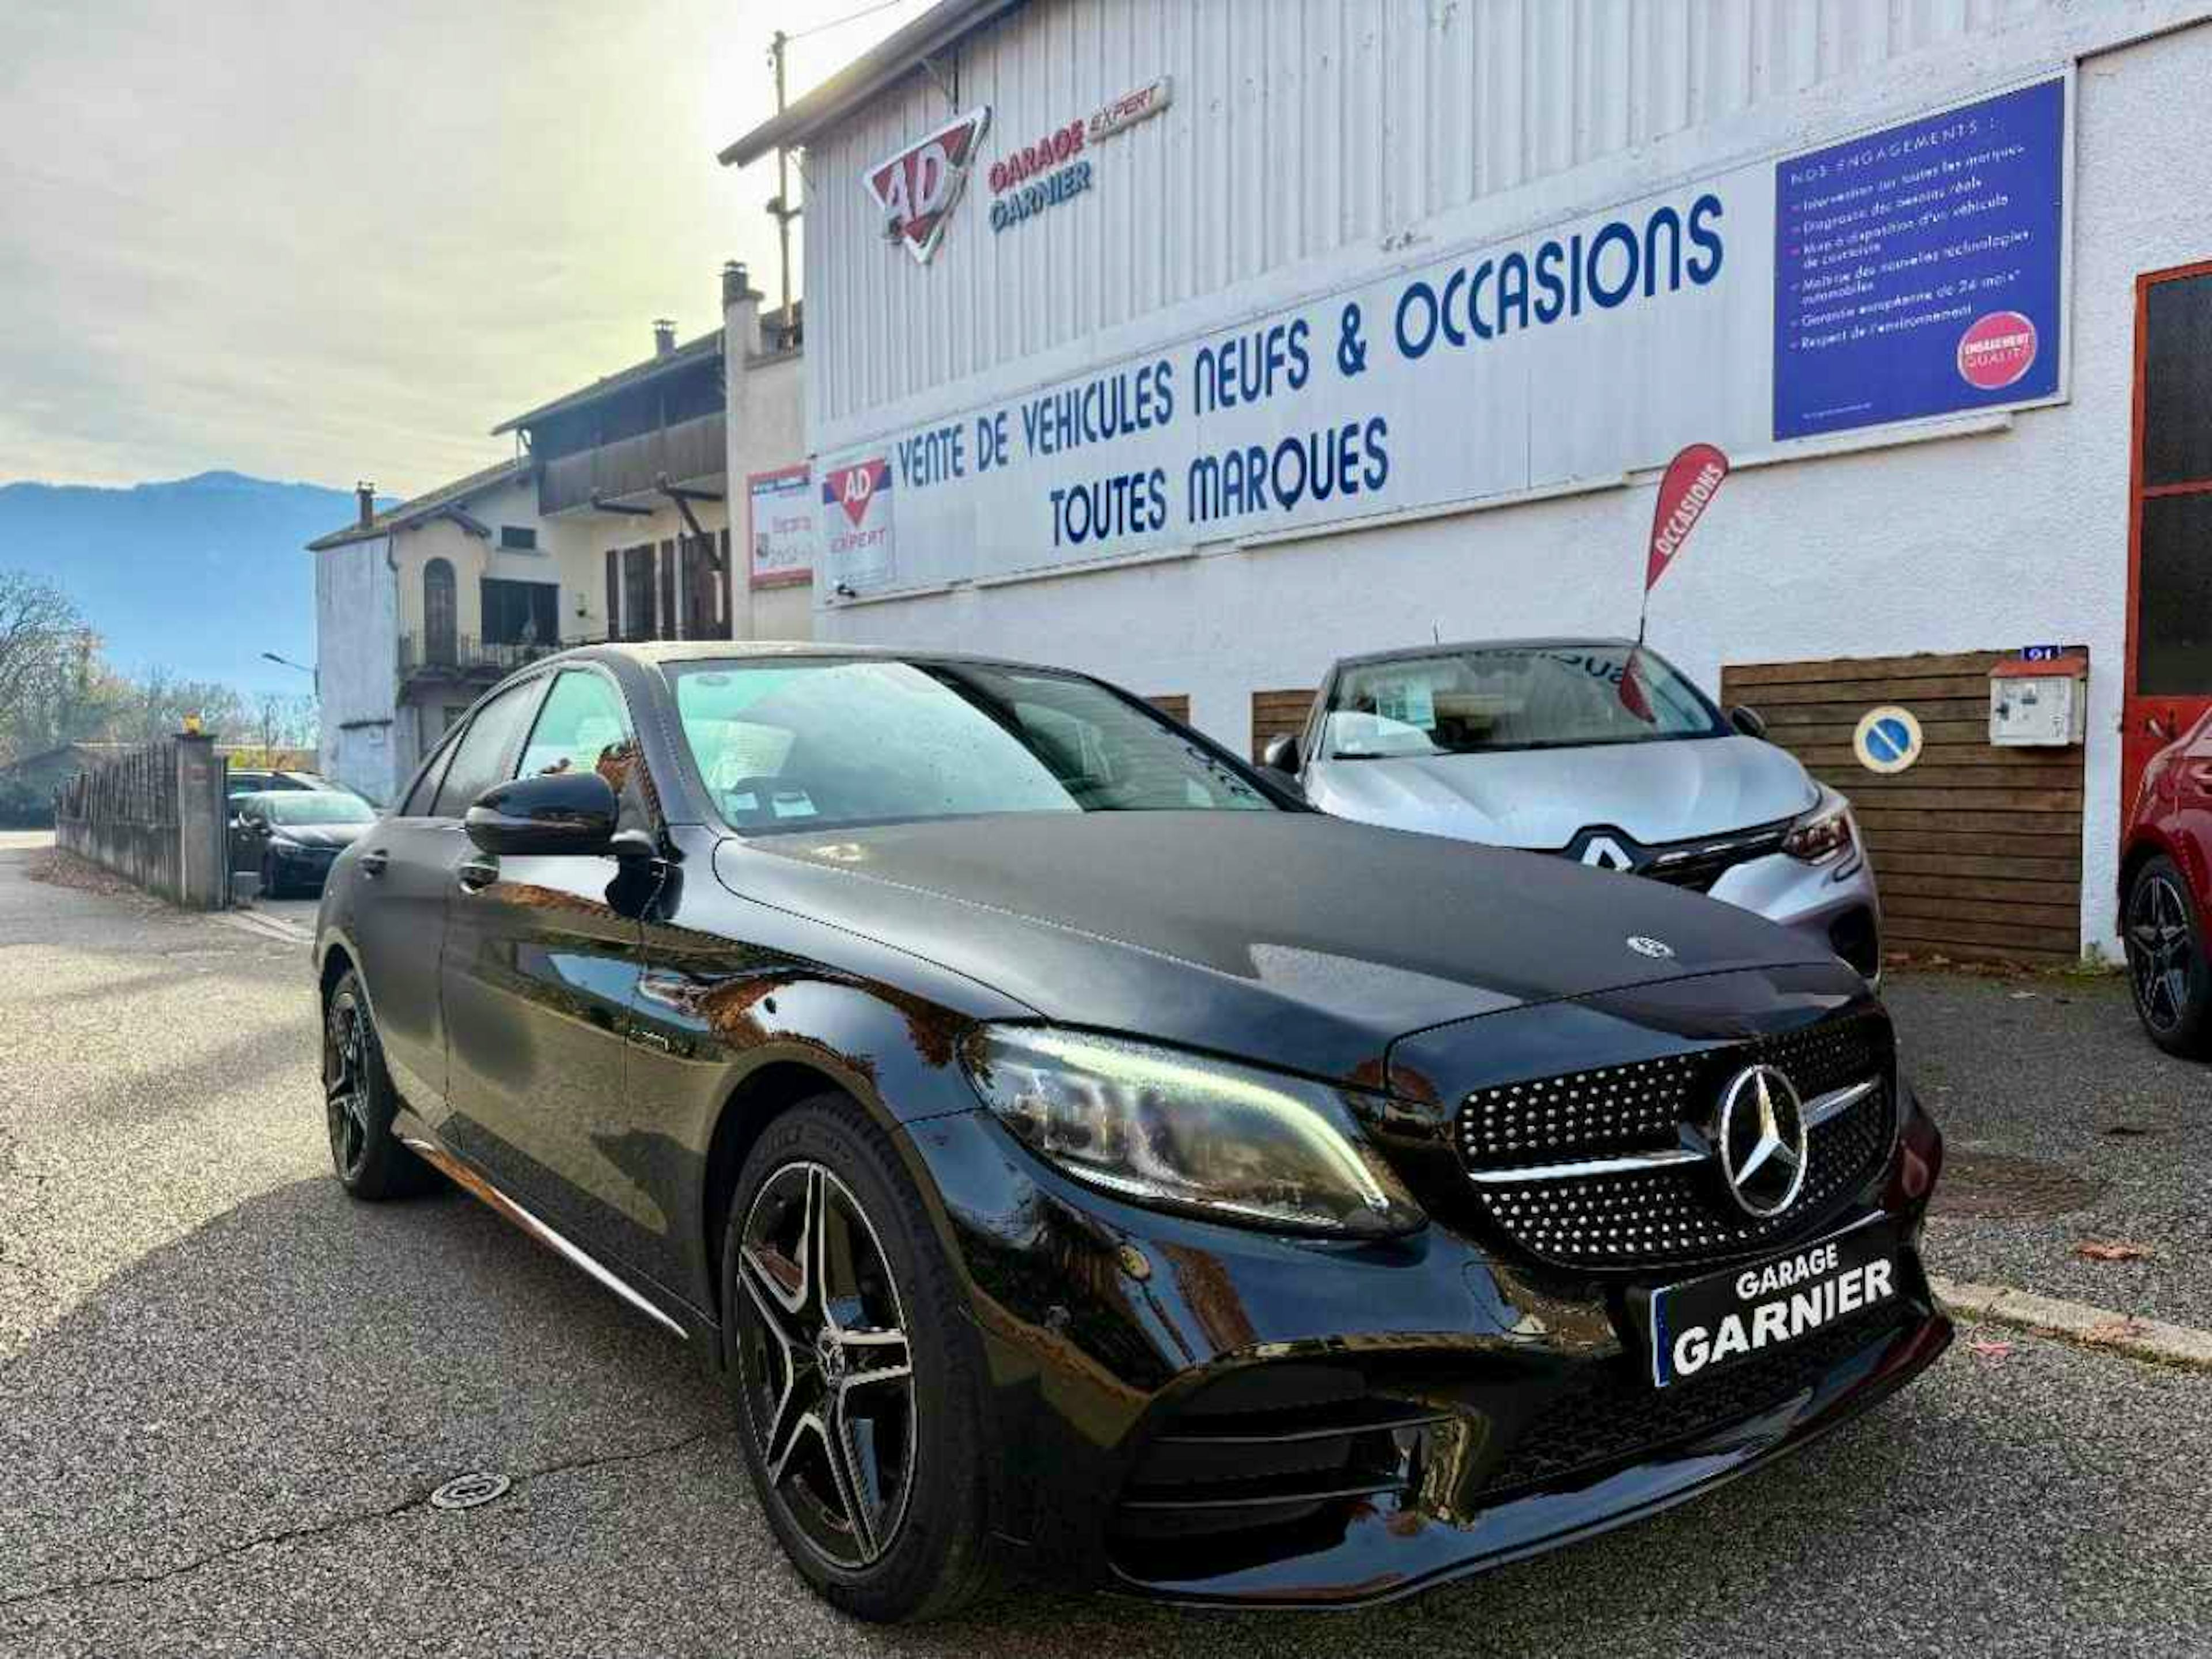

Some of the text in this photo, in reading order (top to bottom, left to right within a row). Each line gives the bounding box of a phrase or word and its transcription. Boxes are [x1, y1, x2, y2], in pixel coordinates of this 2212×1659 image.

[884, 142, 947, 224] AD
[989, 86, 1155, 193] GARAGE EXPERT
[1790, 165, 1826, 186] NOS
[1836, 119, 1977, 171] ENGAGEMENTS
[990, 161, 1092, 232] GARNIER
[899, 194, 1724, 488] VENTE DE VEHICULES NEUFS & OCCASIONS
[843, 468, 871, 503] AD
[1051, 416, 1389, 547] TOUTES MARQUES
[1656, 463, 1724, 556] OCCASIONS
[1736, 1242, 1839, 1300] GARAGE
[1673, 1258, 1894, 1376] GARNIER
